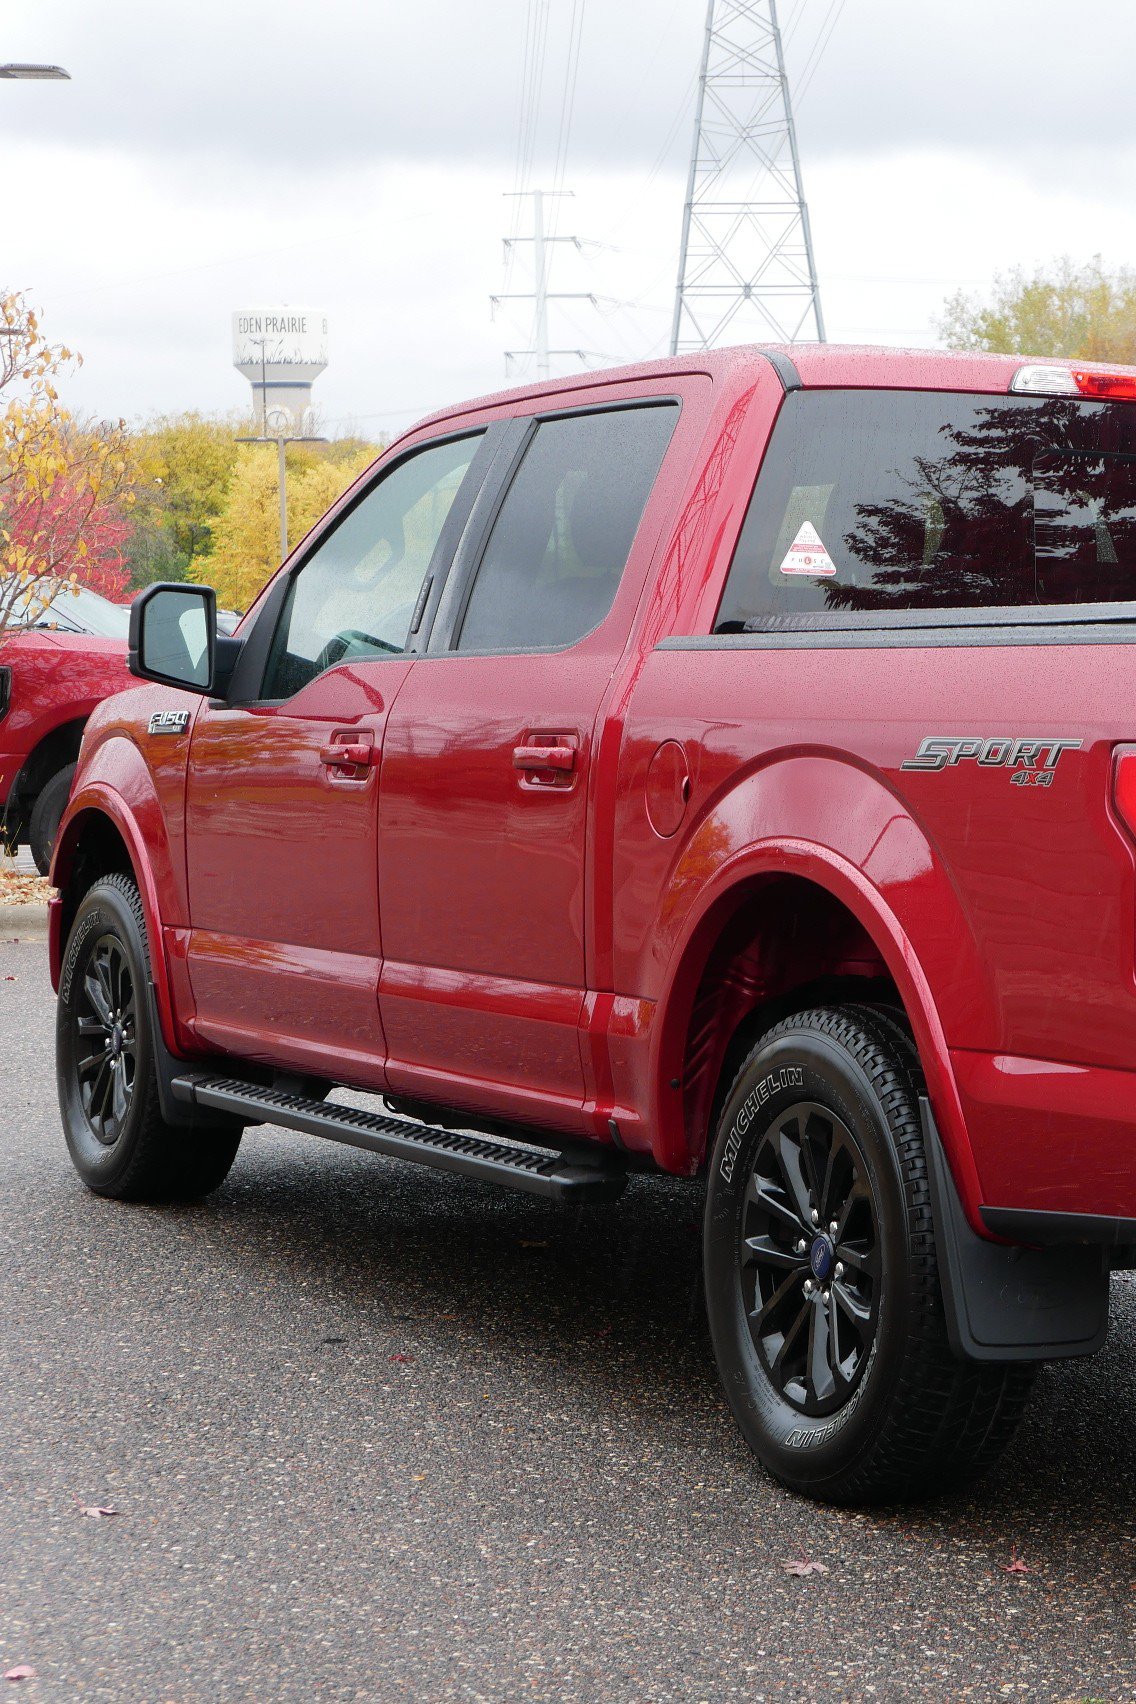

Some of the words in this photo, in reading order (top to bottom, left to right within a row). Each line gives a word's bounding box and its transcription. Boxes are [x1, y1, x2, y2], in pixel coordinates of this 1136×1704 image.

[238, 317, 262, 334] EDEN
[265, 317, 307, 334] PRAIRIE
[899, 736, 1085, 773] SPORT
[719, 1066, 804, 1184] MICHELIN
